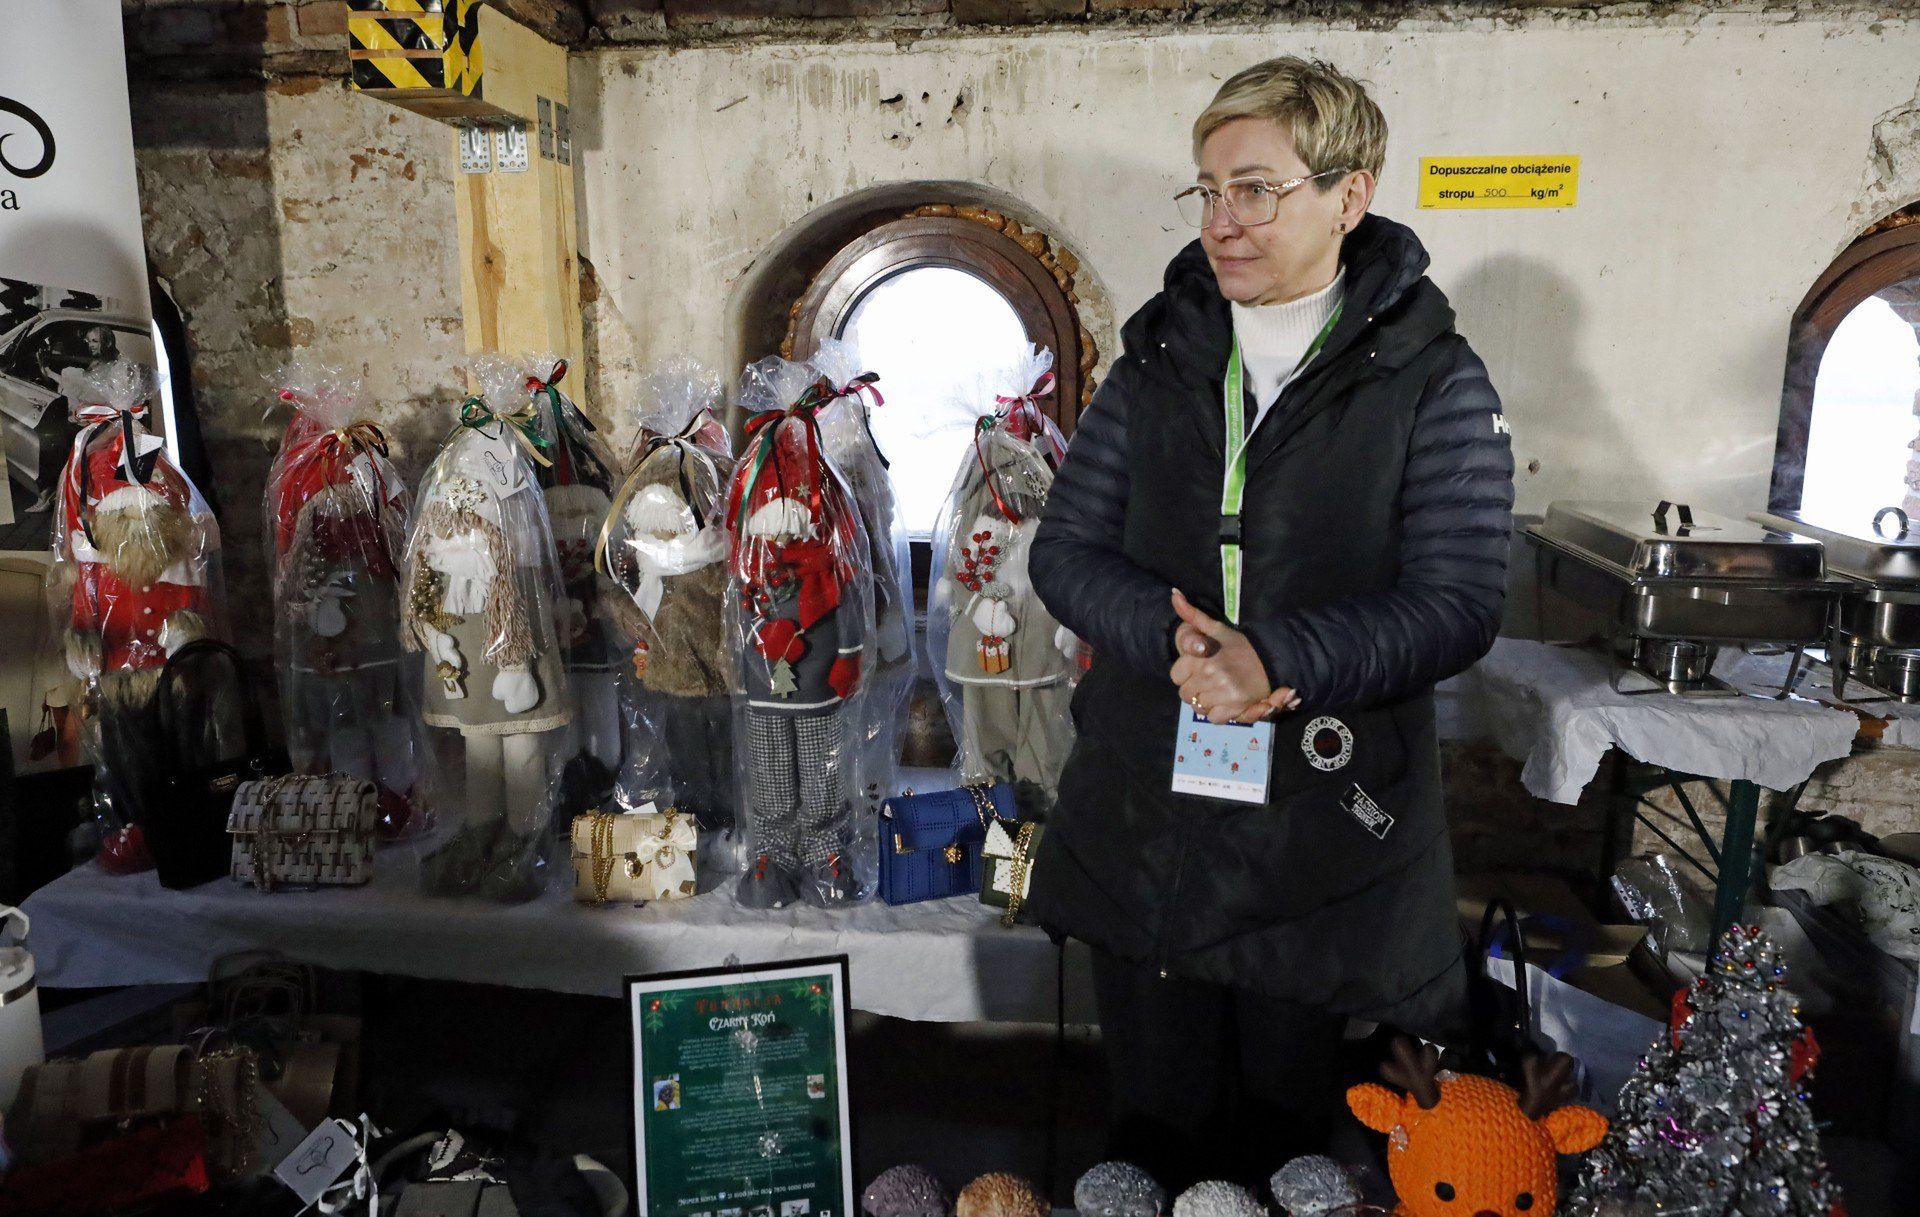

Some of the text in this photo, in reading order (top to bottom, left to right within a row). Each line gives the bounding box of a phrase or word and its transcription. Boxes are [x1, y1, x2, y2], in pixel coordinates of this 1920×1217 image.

[1429, 163, 1571, 178] Dopuszczalne obciążenie
[1438, 188, 1475, 200] stropu
[1484, 188, 1507, 198] 500
[1353, 792, 1387, 825] FASHION
